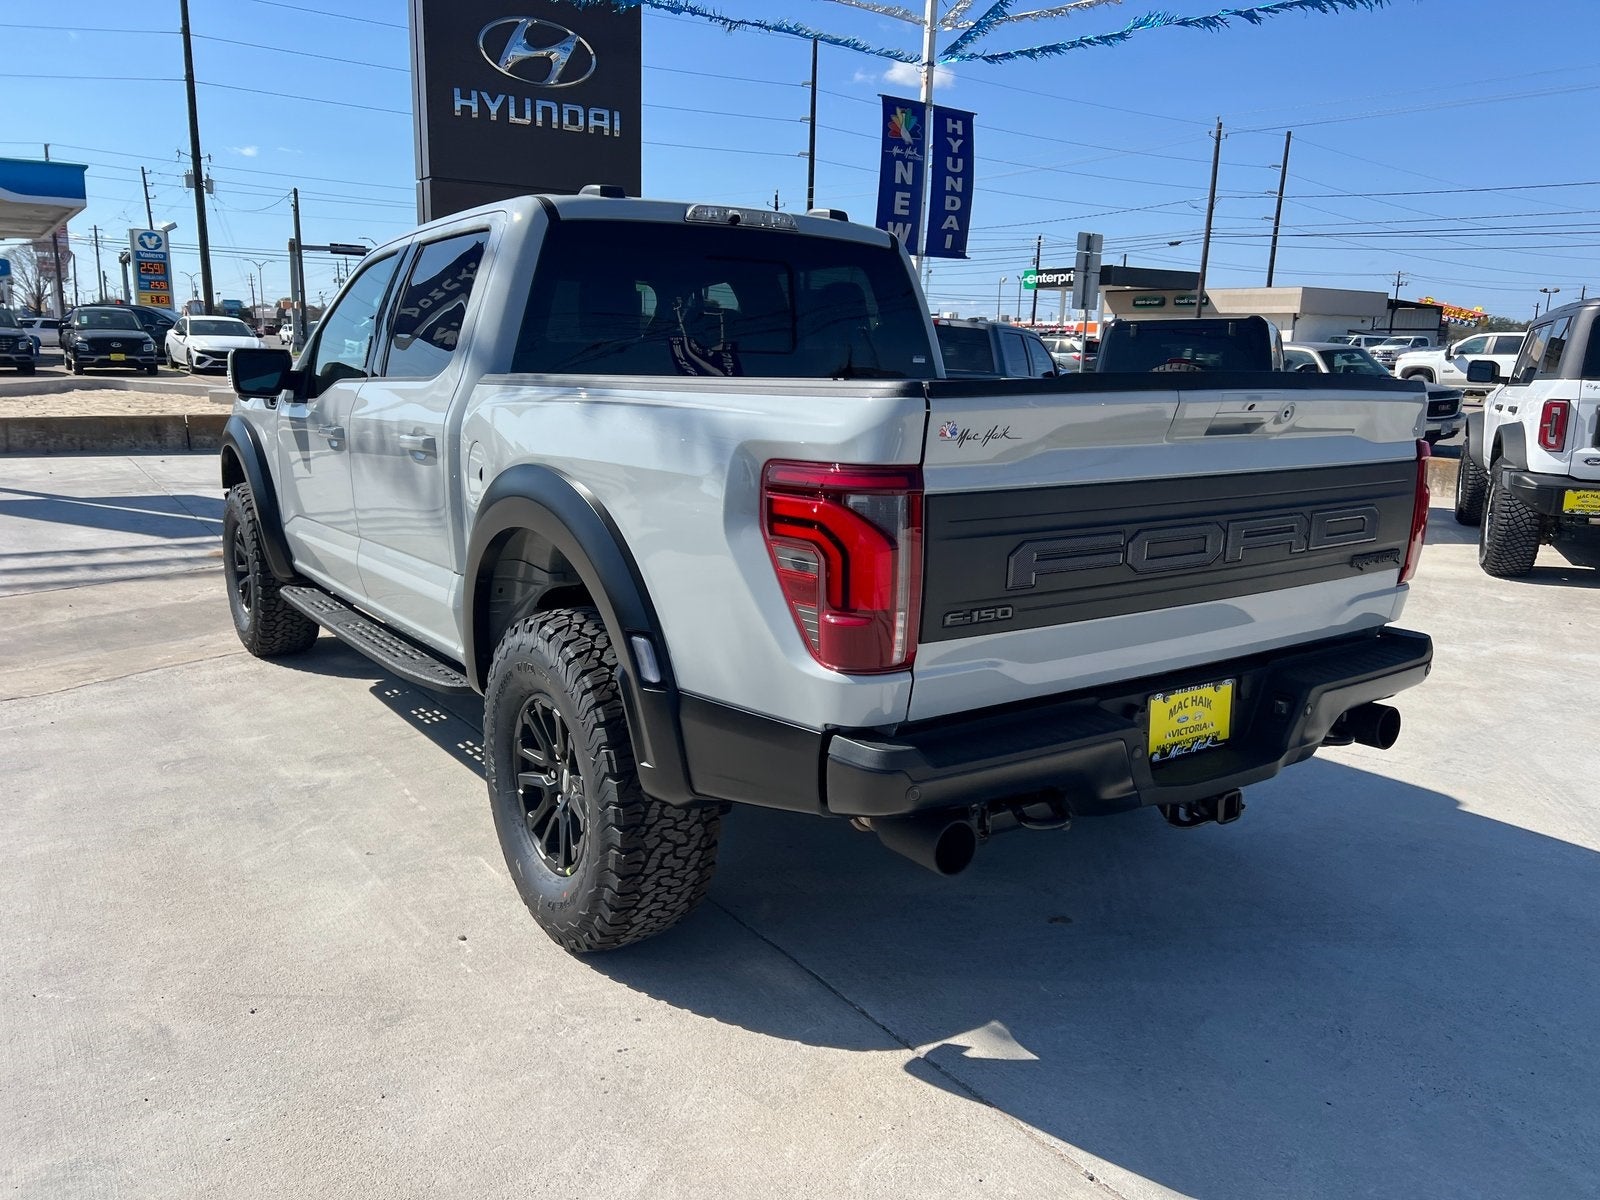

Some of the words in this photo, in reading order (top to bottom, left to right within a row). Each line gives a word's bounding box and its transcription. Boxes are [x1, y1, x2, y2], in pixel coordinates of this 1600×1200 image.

[453, 87, 621, 137] HYUNDAI
[941, 117, 964, 249] HYUNDAI
[887, 160, 913, 246] NEW
[139, 251, 164, 259] Valero
[1023, 270, 1075, 285] enterpri
[981, 425, 1022, 447] Haik
[1005, 504, 1380, 591] FORD
[943, 605, 1013, 627] F-150
[1168, 697, 1189, 720] MAC
[1190, 695, 1212, 711] HAIK
[1171, 722, 1208, 737] VICTORIA
